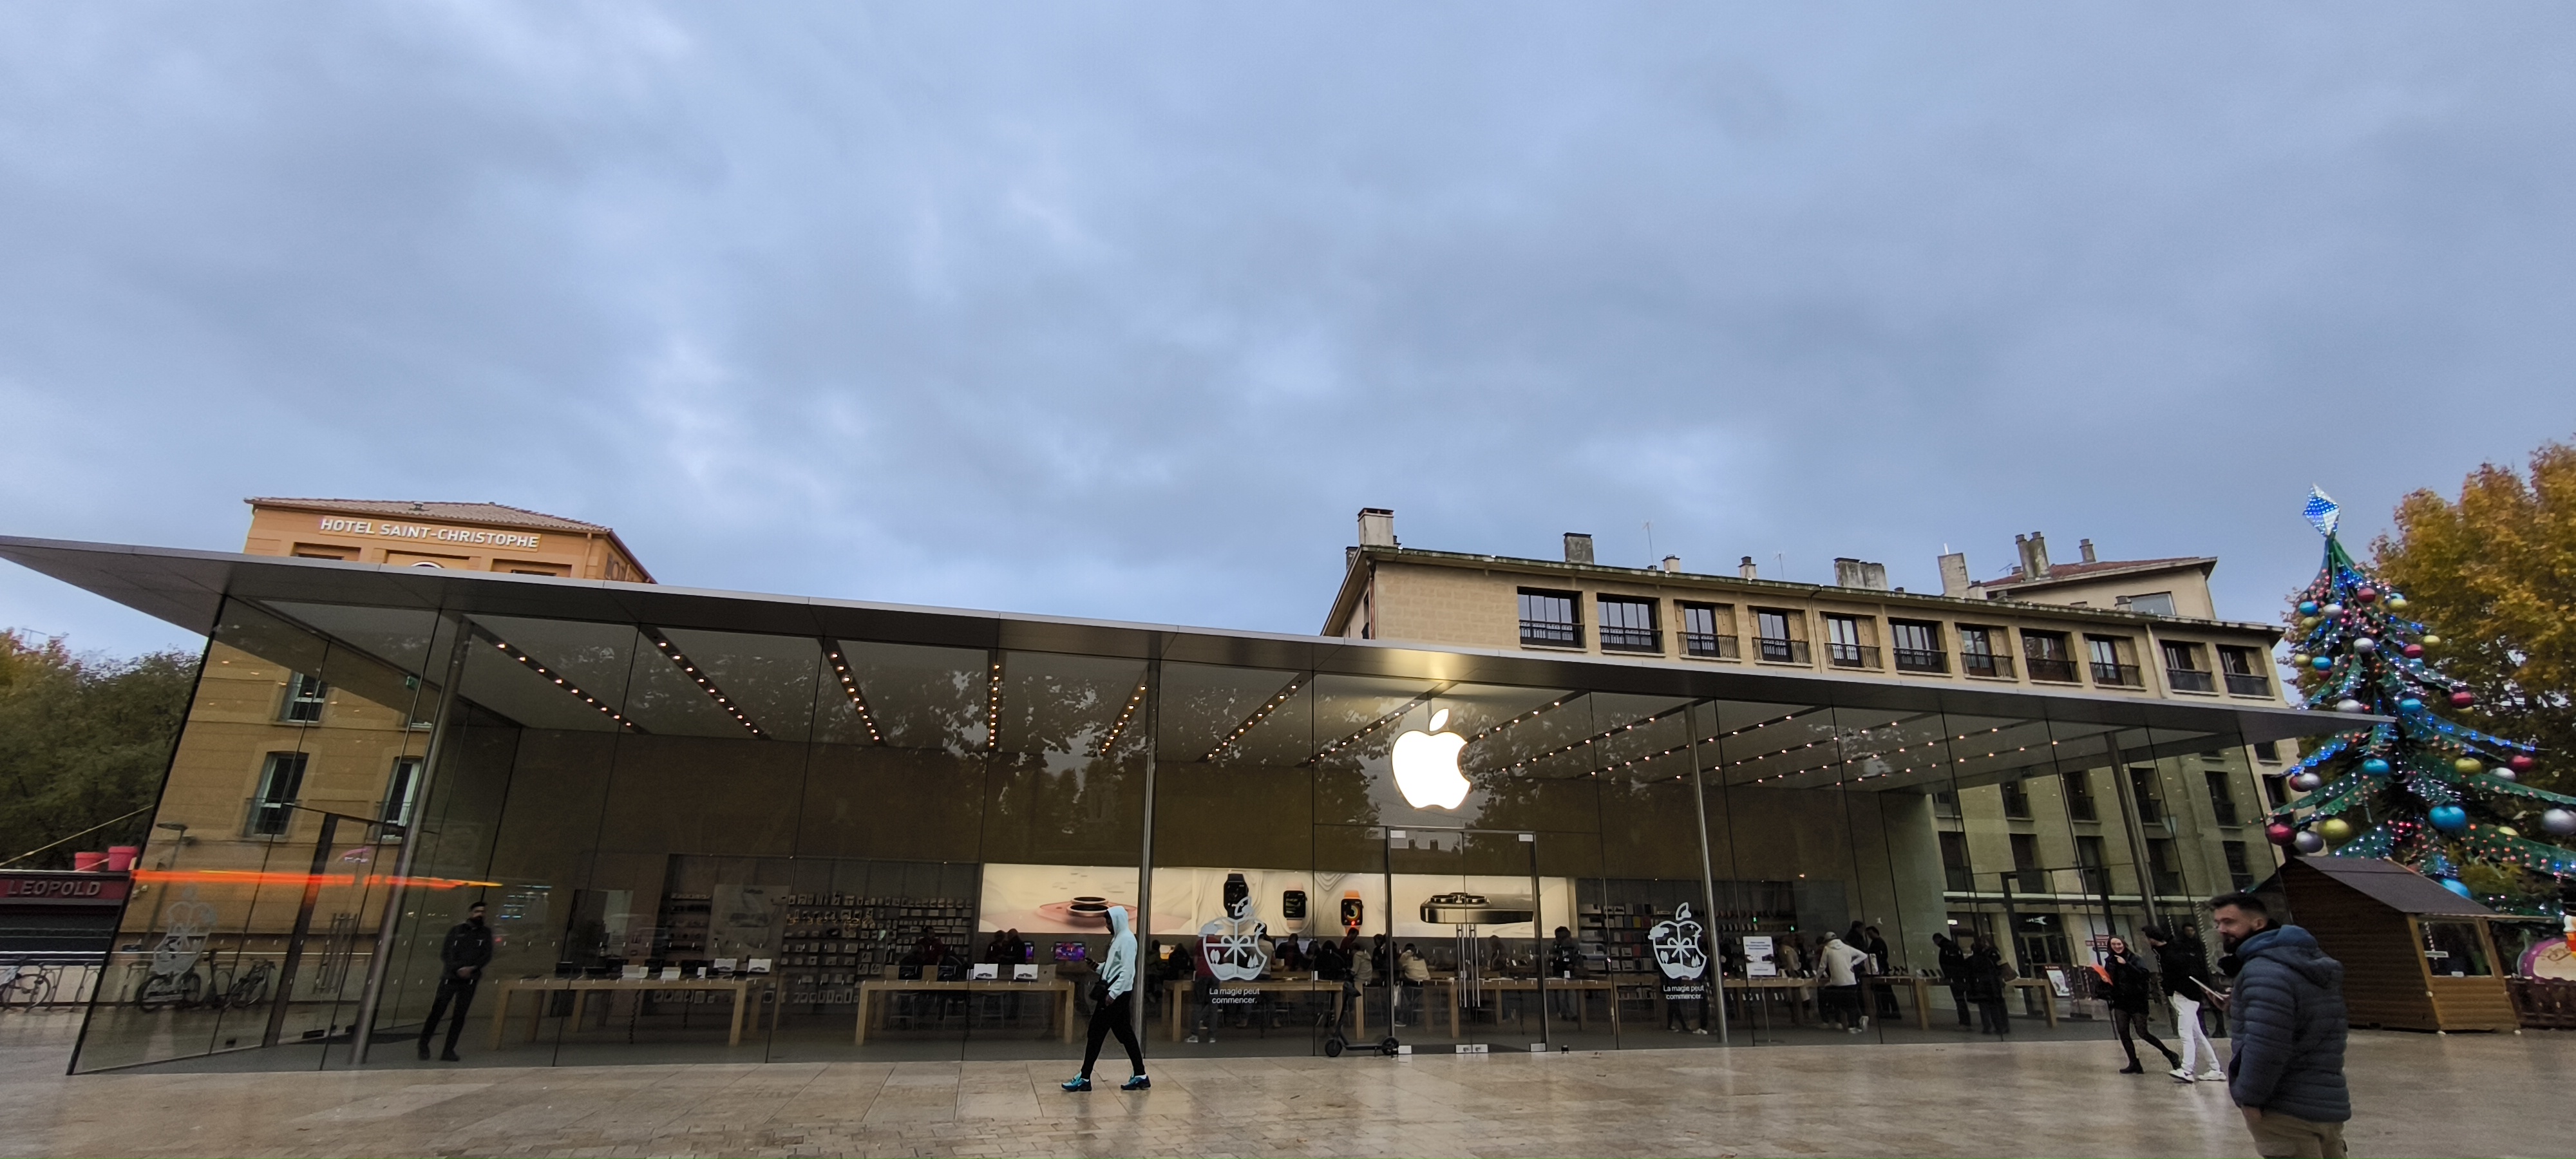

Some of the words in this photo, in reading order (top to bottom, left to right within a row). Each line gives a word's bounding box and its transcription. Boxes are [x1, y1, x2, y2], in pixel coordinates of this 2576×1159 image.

[321, 518, 375, 535] HOTEL
[379, 523, 540, 548] SAINT-CHRISTOPHE
[7, 880, 101, 896] LEOPOLD
[1243, 988, 1260, 996] peut
